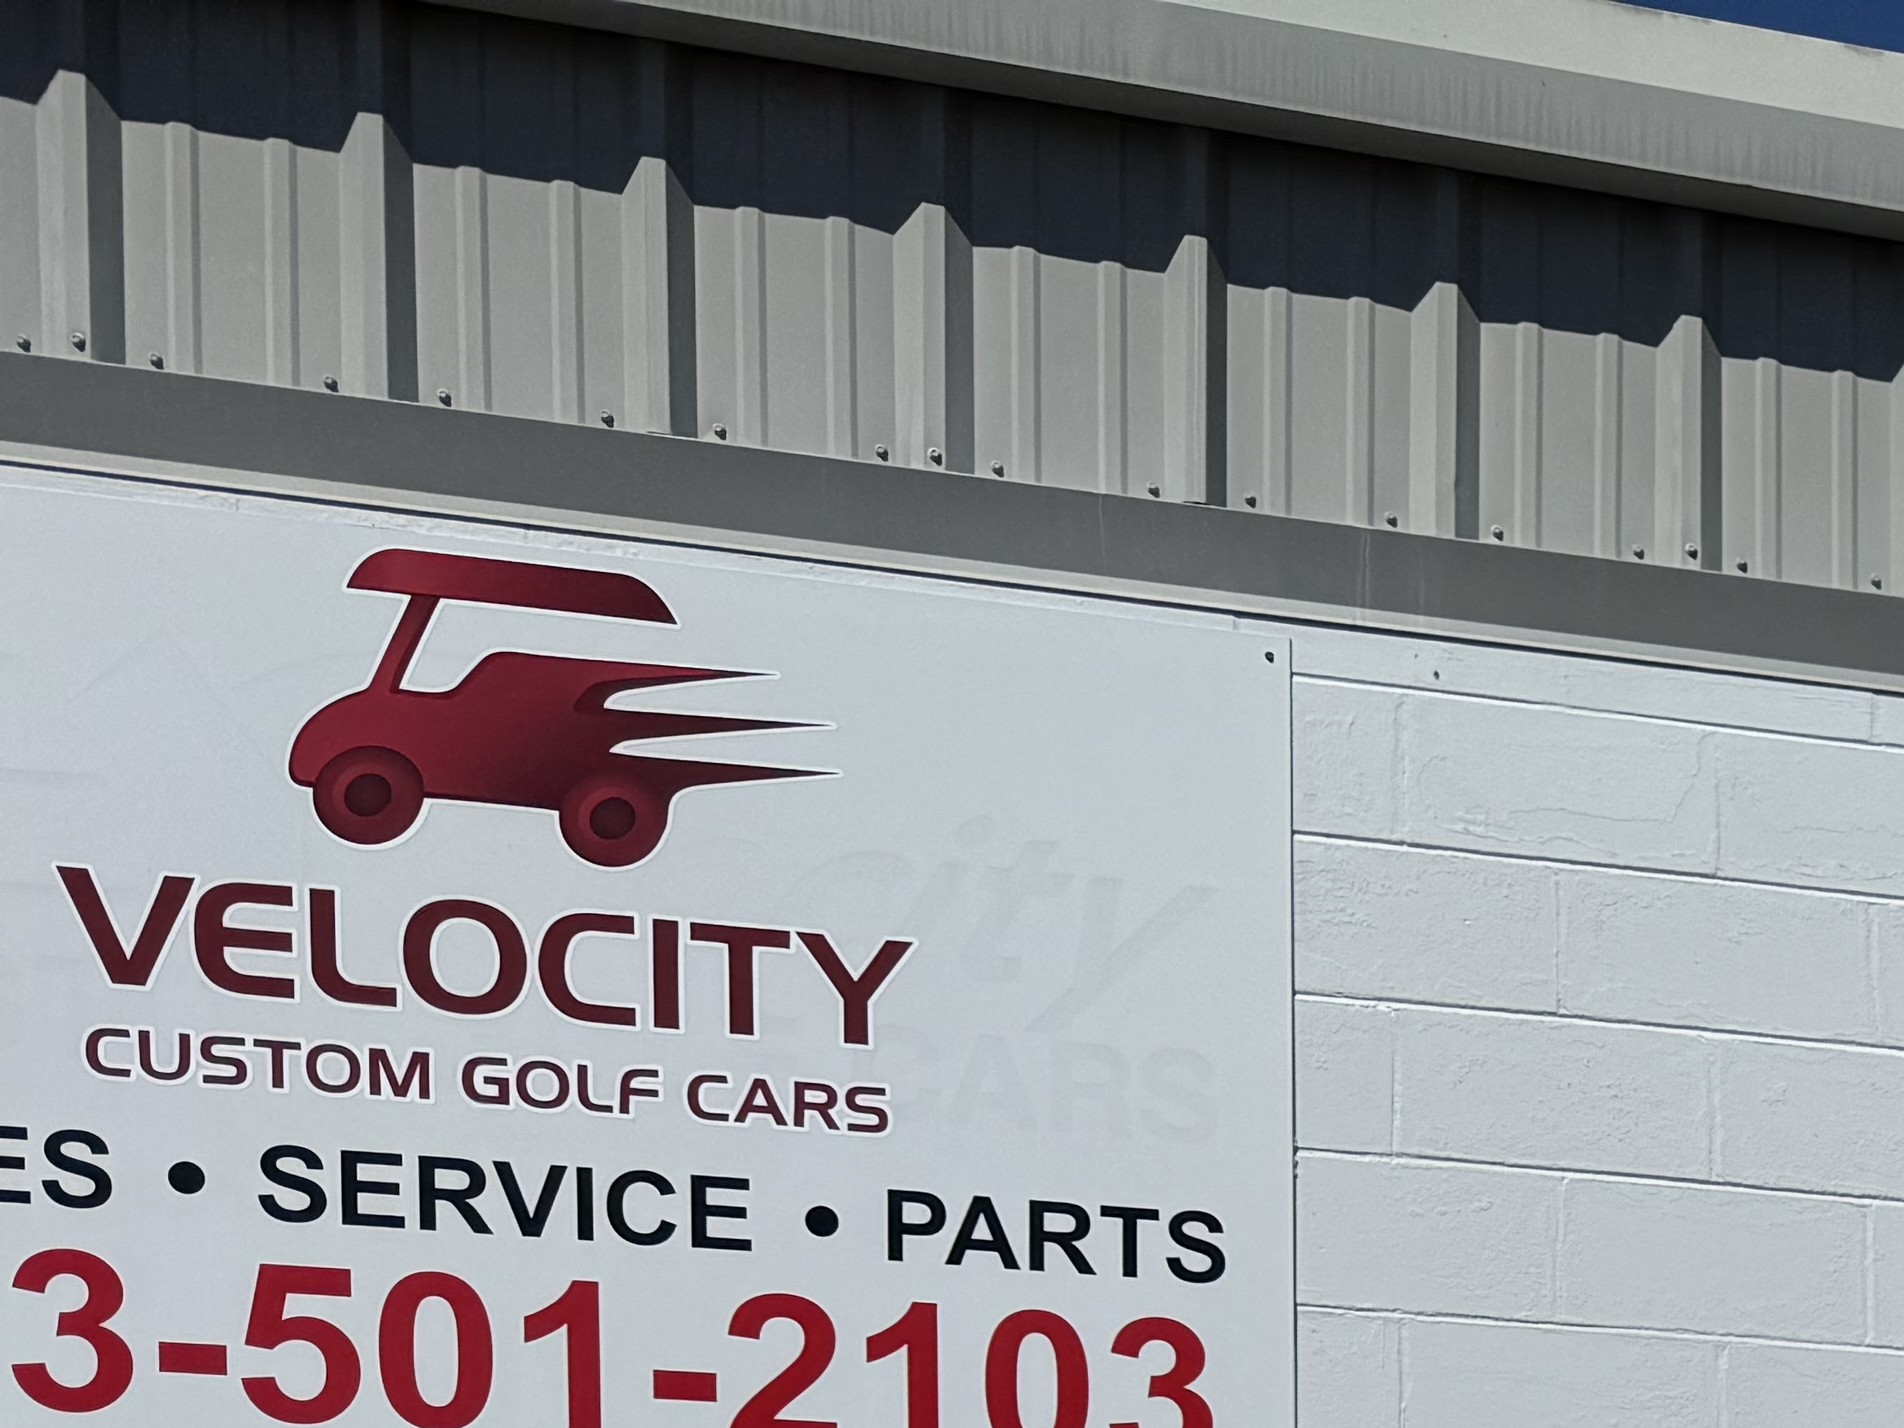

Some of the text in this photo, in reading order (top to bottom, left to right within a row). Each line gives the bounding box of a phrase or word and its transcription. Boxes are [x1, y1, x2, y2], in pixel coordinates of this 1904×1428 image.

[57, 867, 909, 1045] VELOCITY
[84, 1028, 889, 1132] CUSTOM GOLF CARS
[258, 1144, 753, 1253] SERVICE
[886, 1188, 1227, 1285] PARTS
